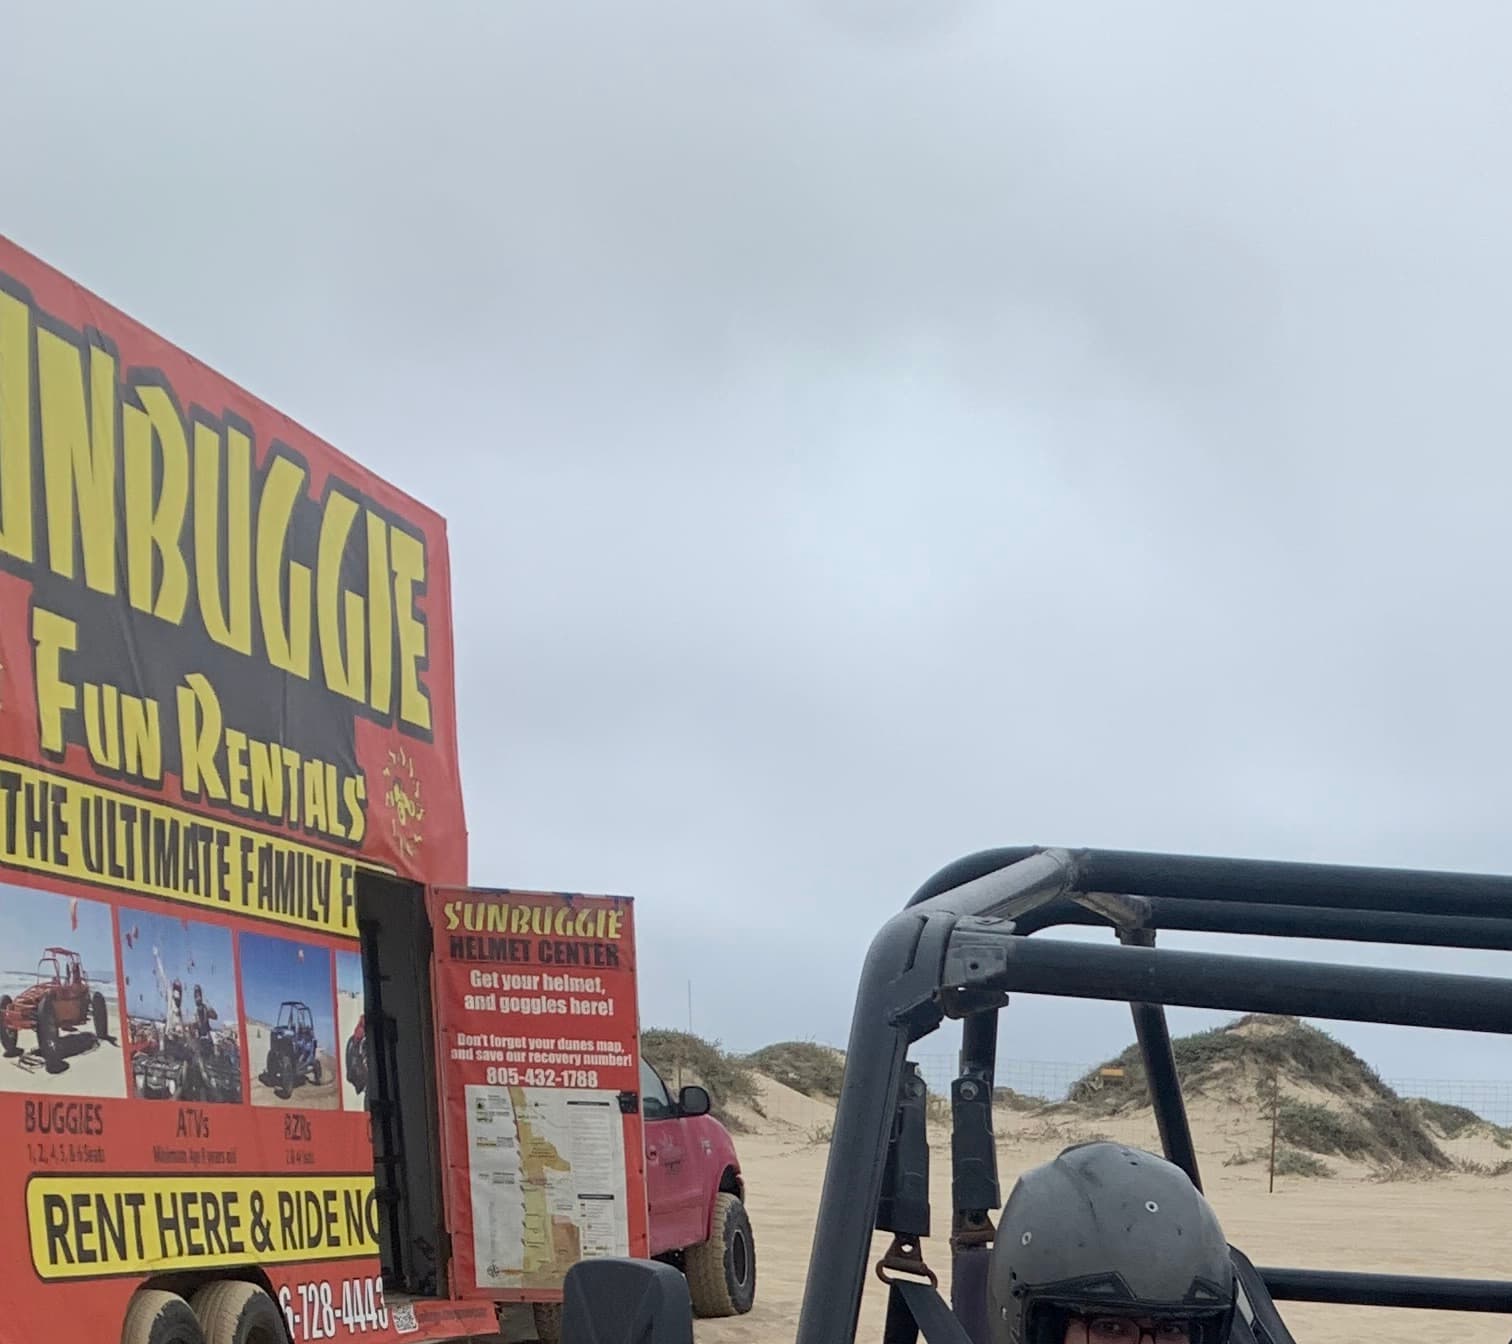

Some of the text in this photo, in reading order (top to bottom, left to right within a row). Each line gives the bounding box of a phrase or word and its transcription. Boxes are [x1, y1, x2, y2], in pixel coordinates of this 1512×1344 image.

[0, 772, 69, 867] THE
[81, 795, 231, 902] ULTIMATE
[241, 836, 331, 924] FAMILY
[444, 901, 624, 939] SUNBUGGIE
[450, 935, 619, 967] HELMET CENTER
[470, 969, 606, 995] Get your helmet,
[464, 994, 614, 1016] and goggles here!
[451, 1047, 632, 1067] and save our recovery number!
[457, 1033, 488, 1047] Don't
[490, 1034, 527, 1049] forget
[528, 1037, 556, 1050] your
[557, 1037, 594, 1051] dunes
[487, 1067, 598, 1088] 805-432-1788
[25, 1100, 104, 1136] BUGGIES
[176, 1108, 209, 1138] ATVs
[43, 1193, 146, 1265] RENT
[155, 1191, 245, 1257] HERE
[249, 1190, 276, 1253] &
[278, 1190, 340, 1251] RIDE
